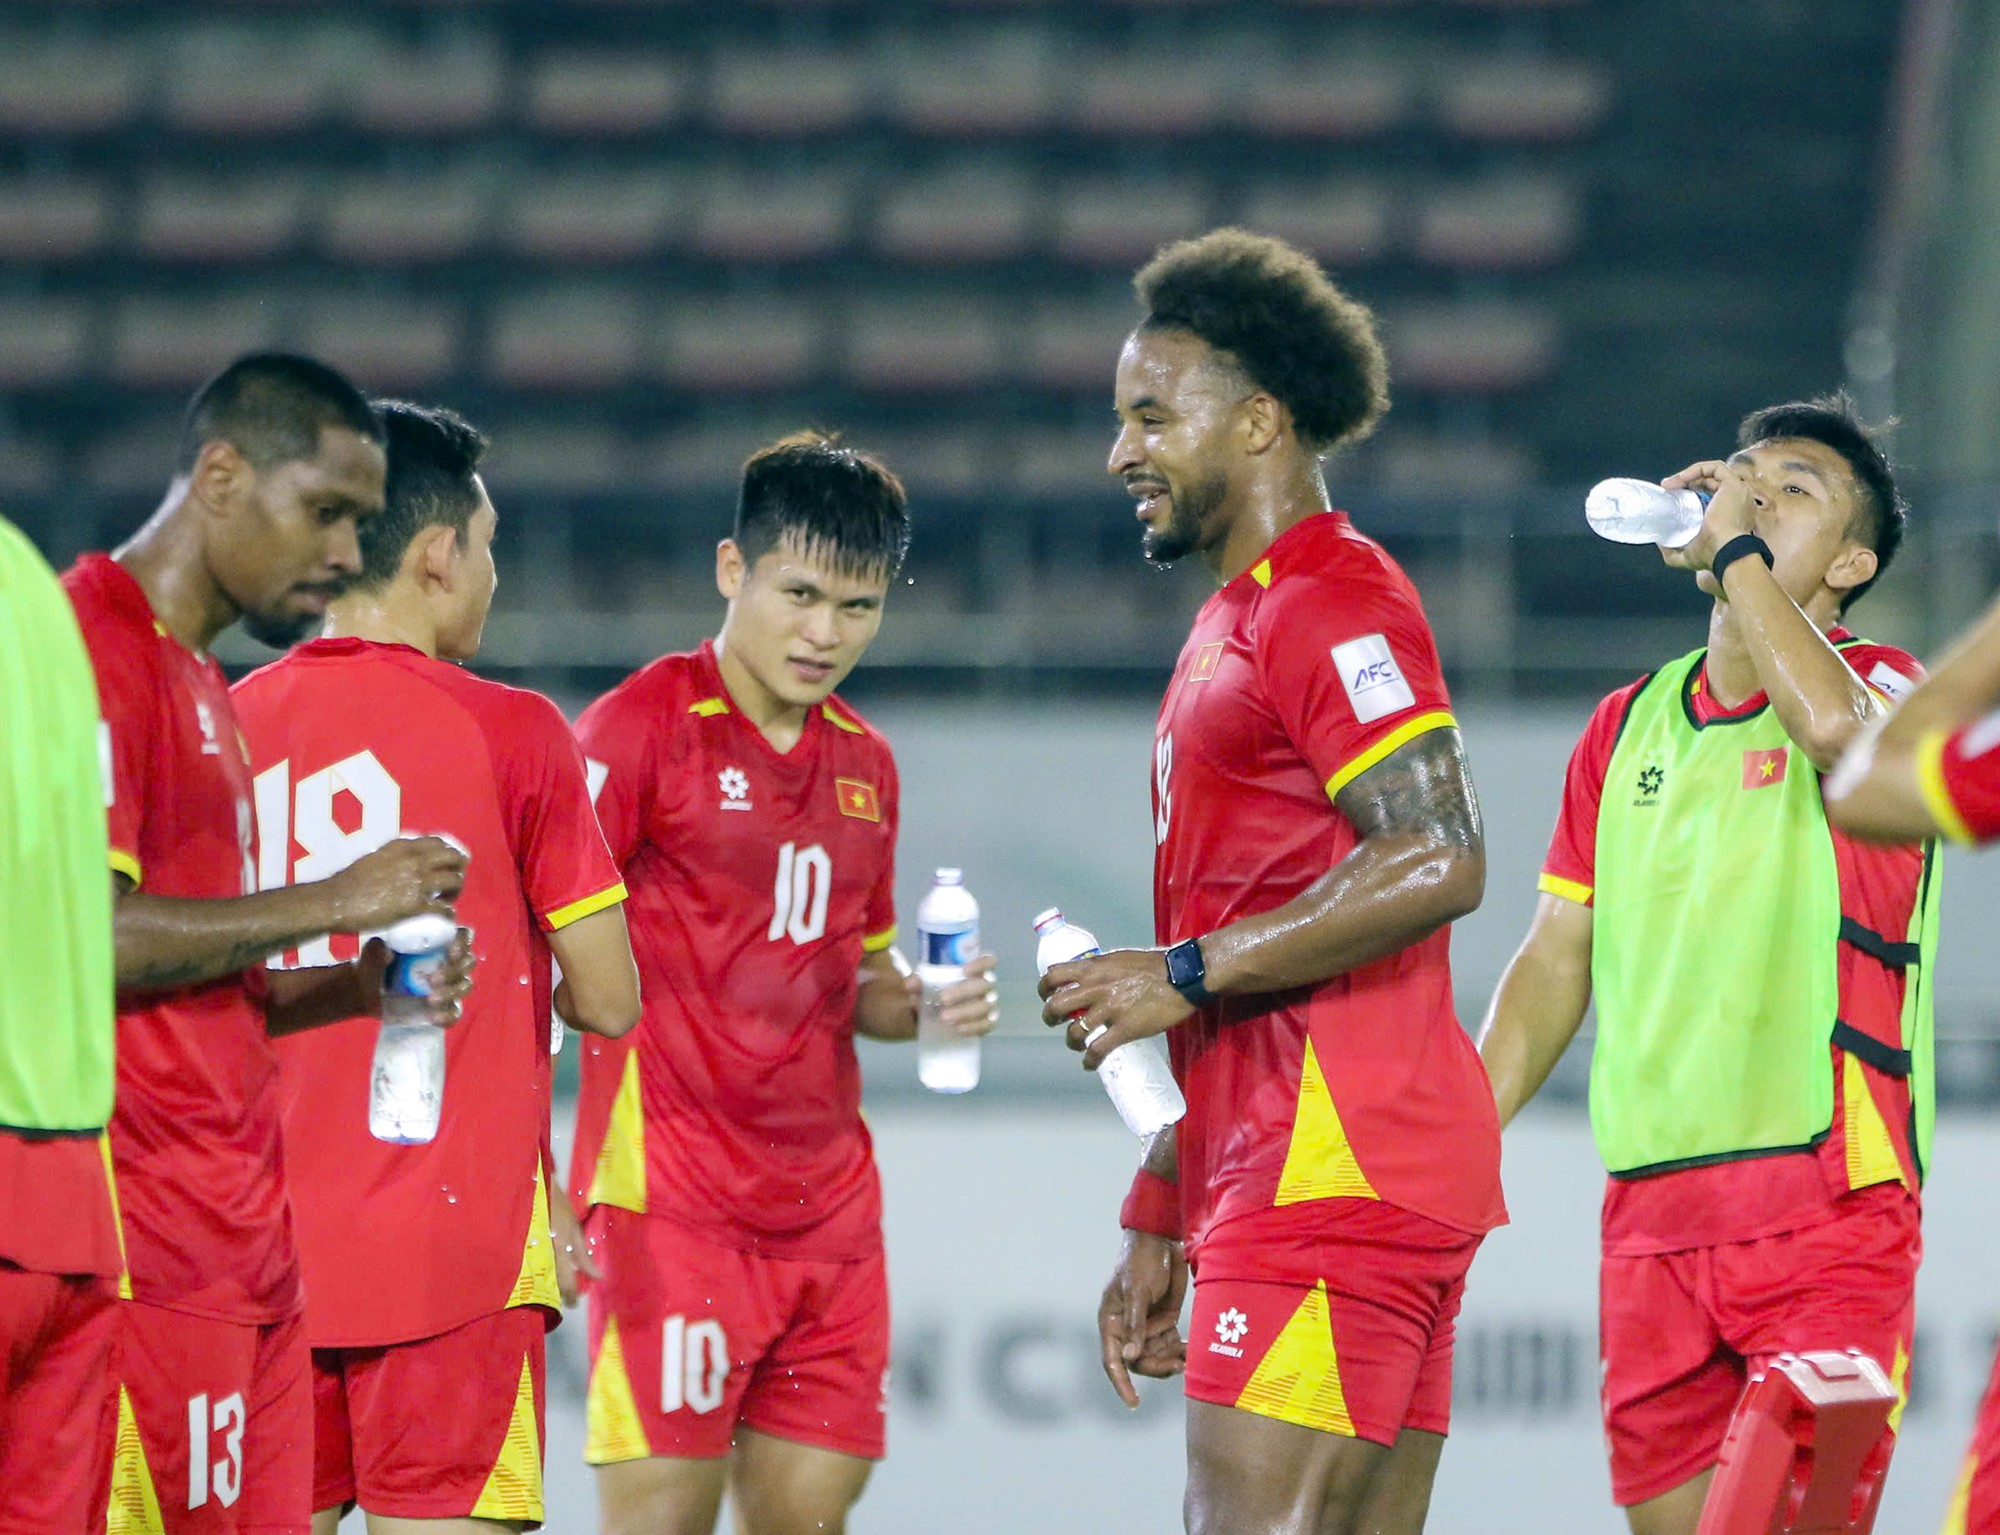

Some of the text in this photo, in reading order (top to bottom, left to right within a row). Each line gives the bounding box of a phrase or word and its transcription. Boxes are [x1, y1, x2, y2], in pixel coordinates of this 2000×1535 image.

[1354, 660, 1392, 689] AFC
[253, 749, 401, 969] 18
[767, 841, 832, 945] 10
[661, 1314, 730, 1415] 10
[188, 1391, 246, 1511] 13
